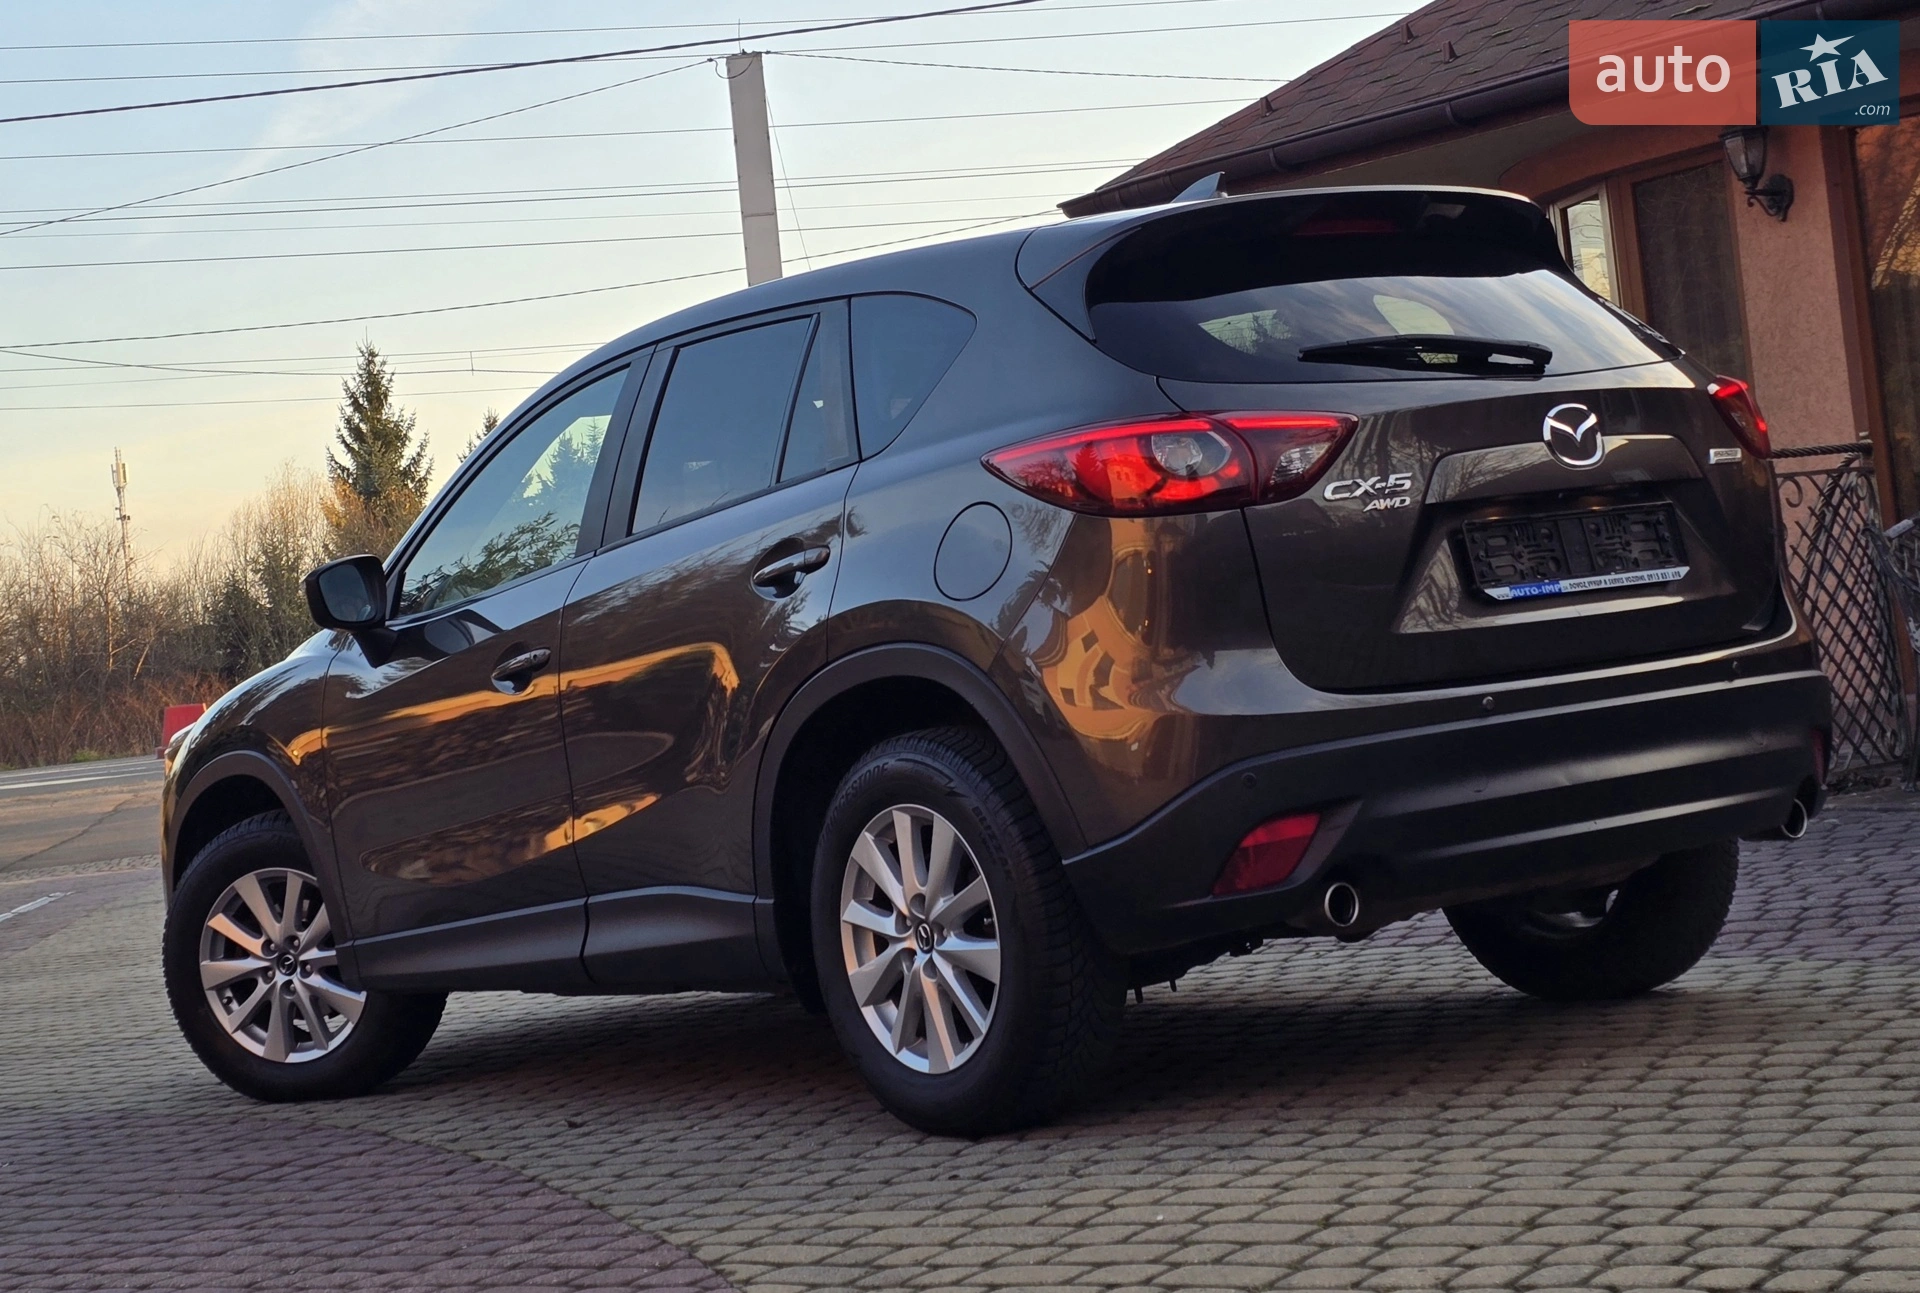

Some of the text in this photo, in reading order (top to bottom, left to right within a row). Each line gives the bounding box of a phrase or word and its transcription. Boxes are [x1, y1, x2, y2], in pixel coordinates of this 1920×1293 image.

[1323, 472, 1413, 501] CX-5
[1362, 496, 1412, 512] AWD
[1510, 583, 1561, 597] AUTO-IMP
